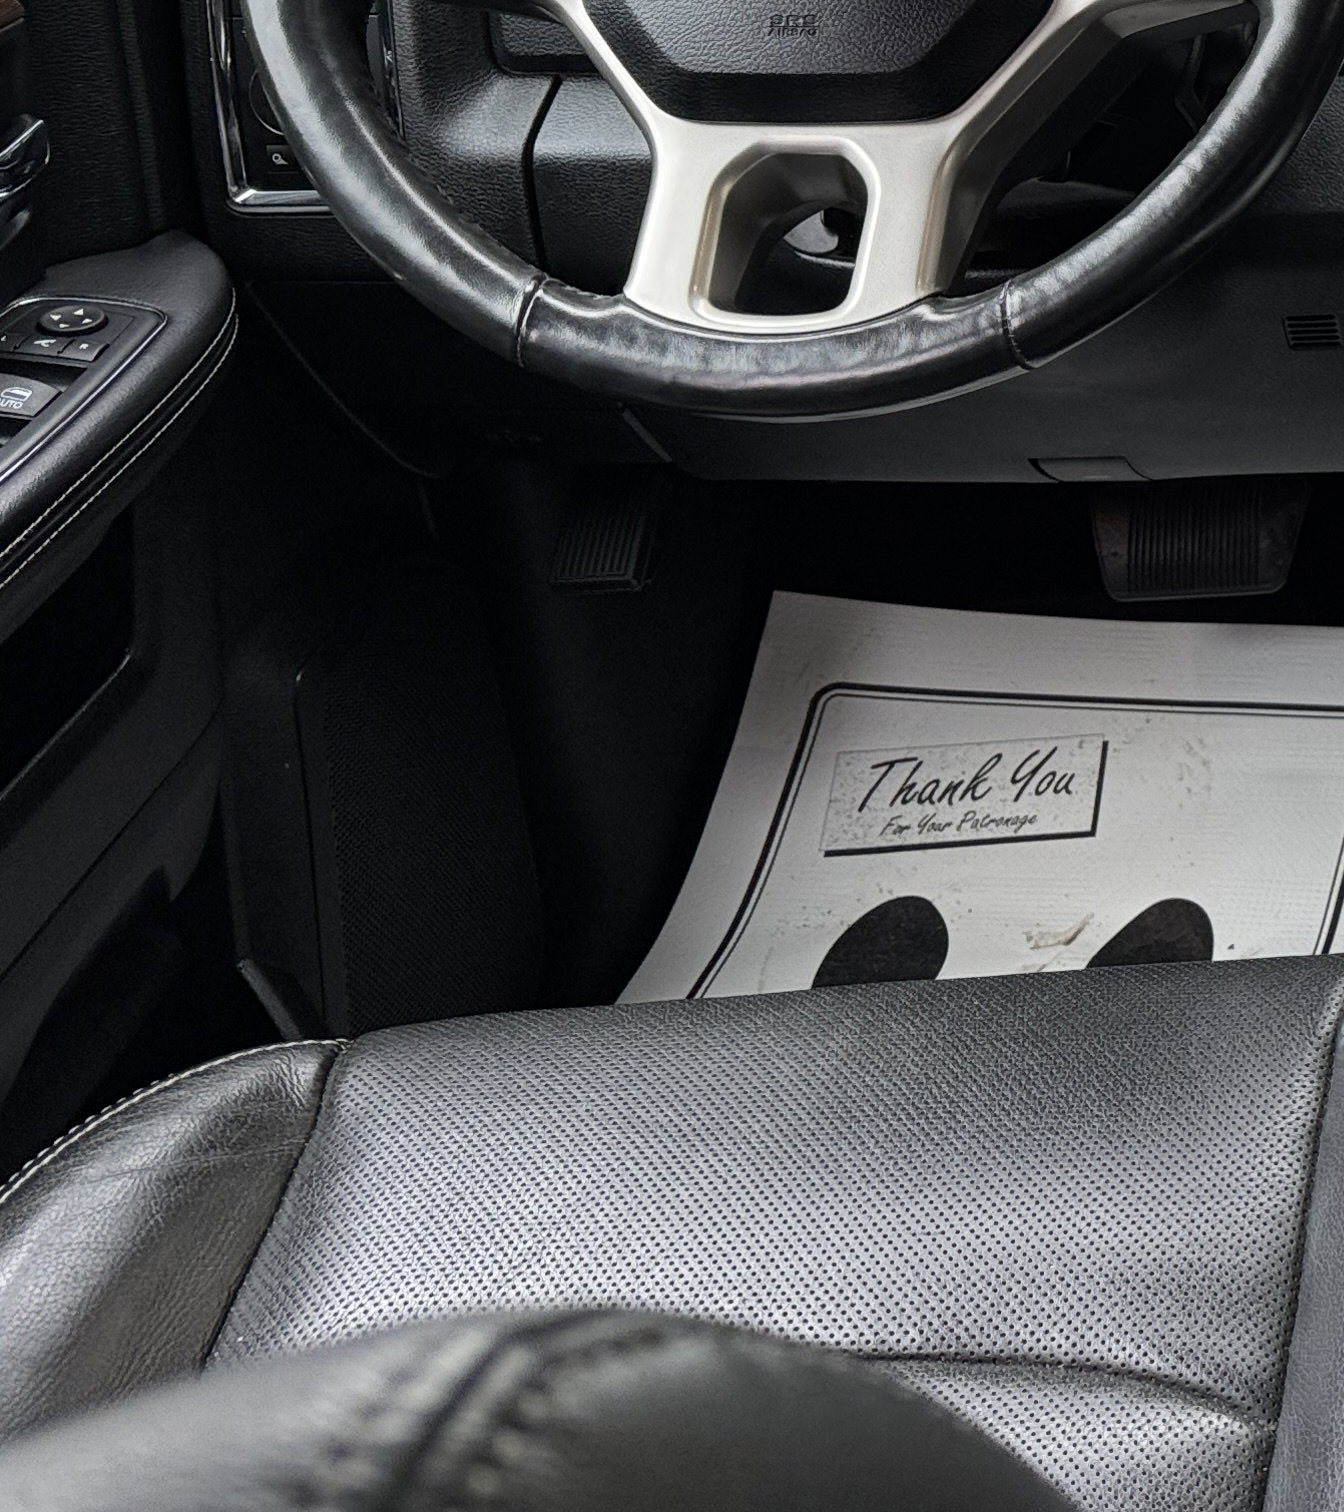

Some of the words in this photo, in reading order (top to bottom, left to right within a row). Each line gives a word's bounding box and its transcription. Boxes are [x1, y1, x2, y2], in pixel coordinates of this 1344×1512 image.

[858, 753, 1003, 813] Thank
[1011, 746, 1076, 803] You
[879, 815, 910, 837] For
[917, 813, 951, 836] Your
[956, 810, 1037, 834] Patronage
